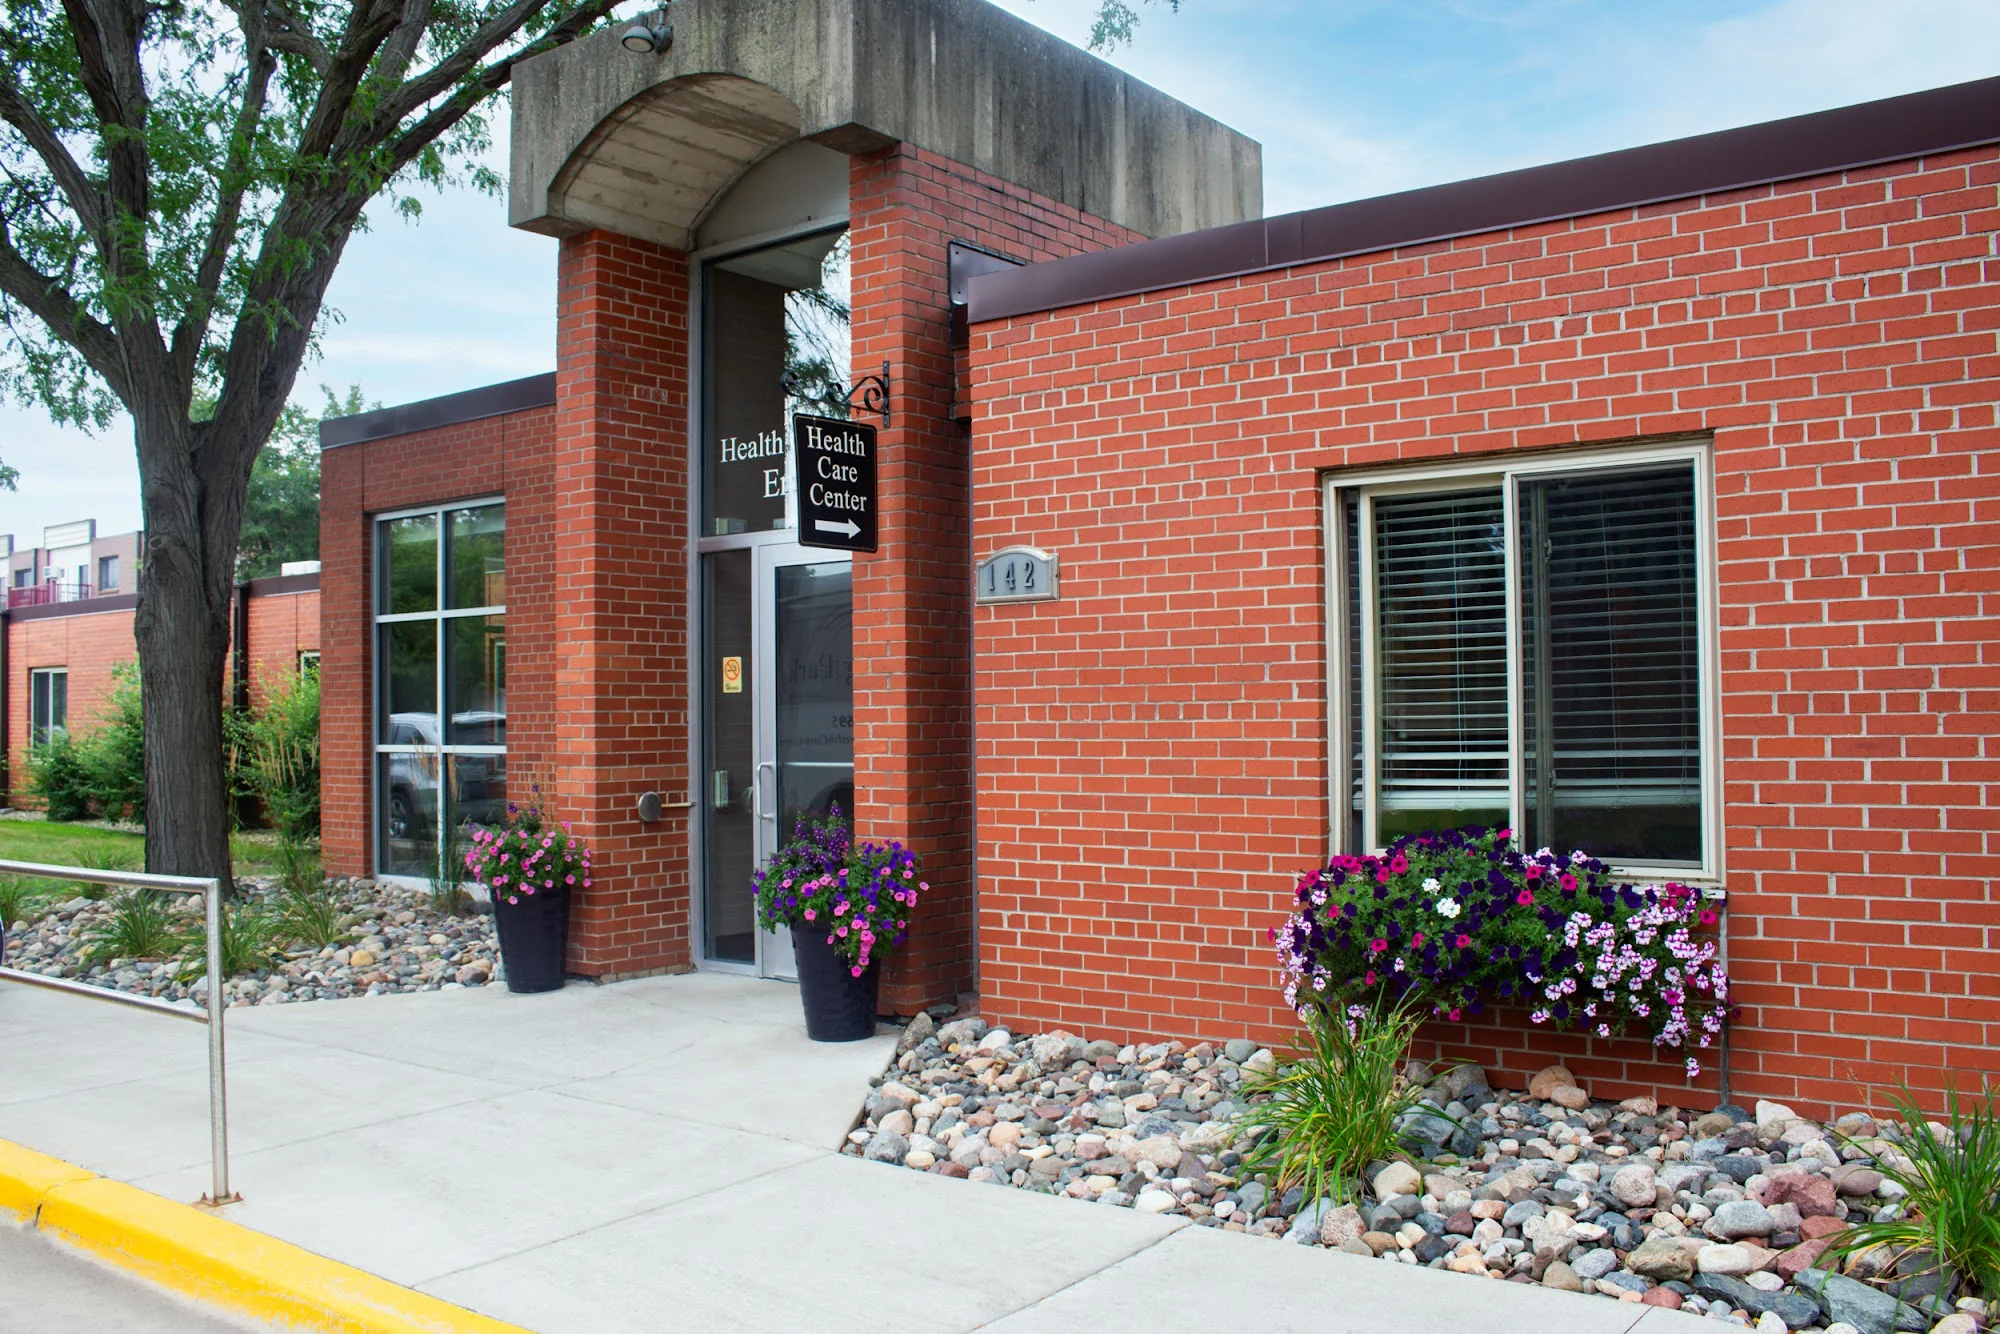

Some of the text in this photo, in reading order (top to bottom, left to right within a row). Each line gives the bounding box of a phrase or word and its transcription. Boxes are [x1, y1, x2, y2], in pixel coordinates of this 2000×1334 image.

[720, 429, 784, 463] Health
[806, 425, 866, 457] Health
[817, 456, 858, 483] Care
[809, 483, 867, 512] Center
[987, 559, 1035, 591] 142
